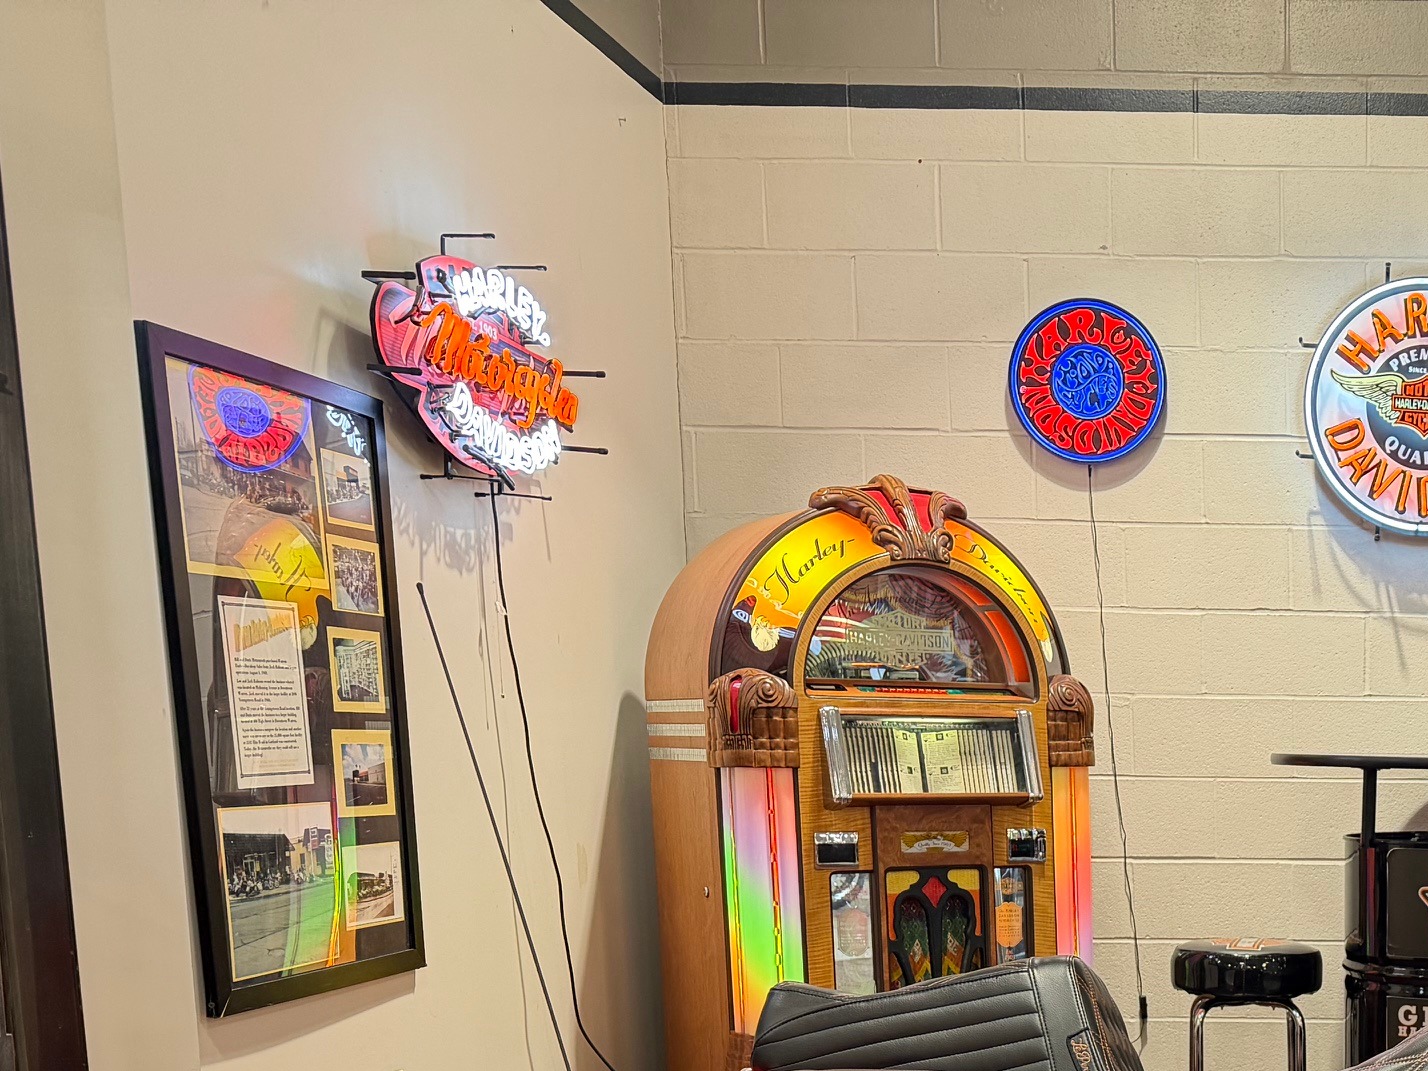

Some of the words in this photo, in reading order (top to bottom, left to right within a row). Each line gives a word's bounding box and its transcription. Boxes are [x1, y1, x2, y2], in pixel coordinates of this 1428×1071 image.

[478, 321, 498, 341] 1903
[1408, 366, 1427, 374] SINCE
[451, 382, 561, 475] DAVIDSON
[1020, 386, 1157, 455] DAVIDSON
[763, 537, 855, 606] Harley-
